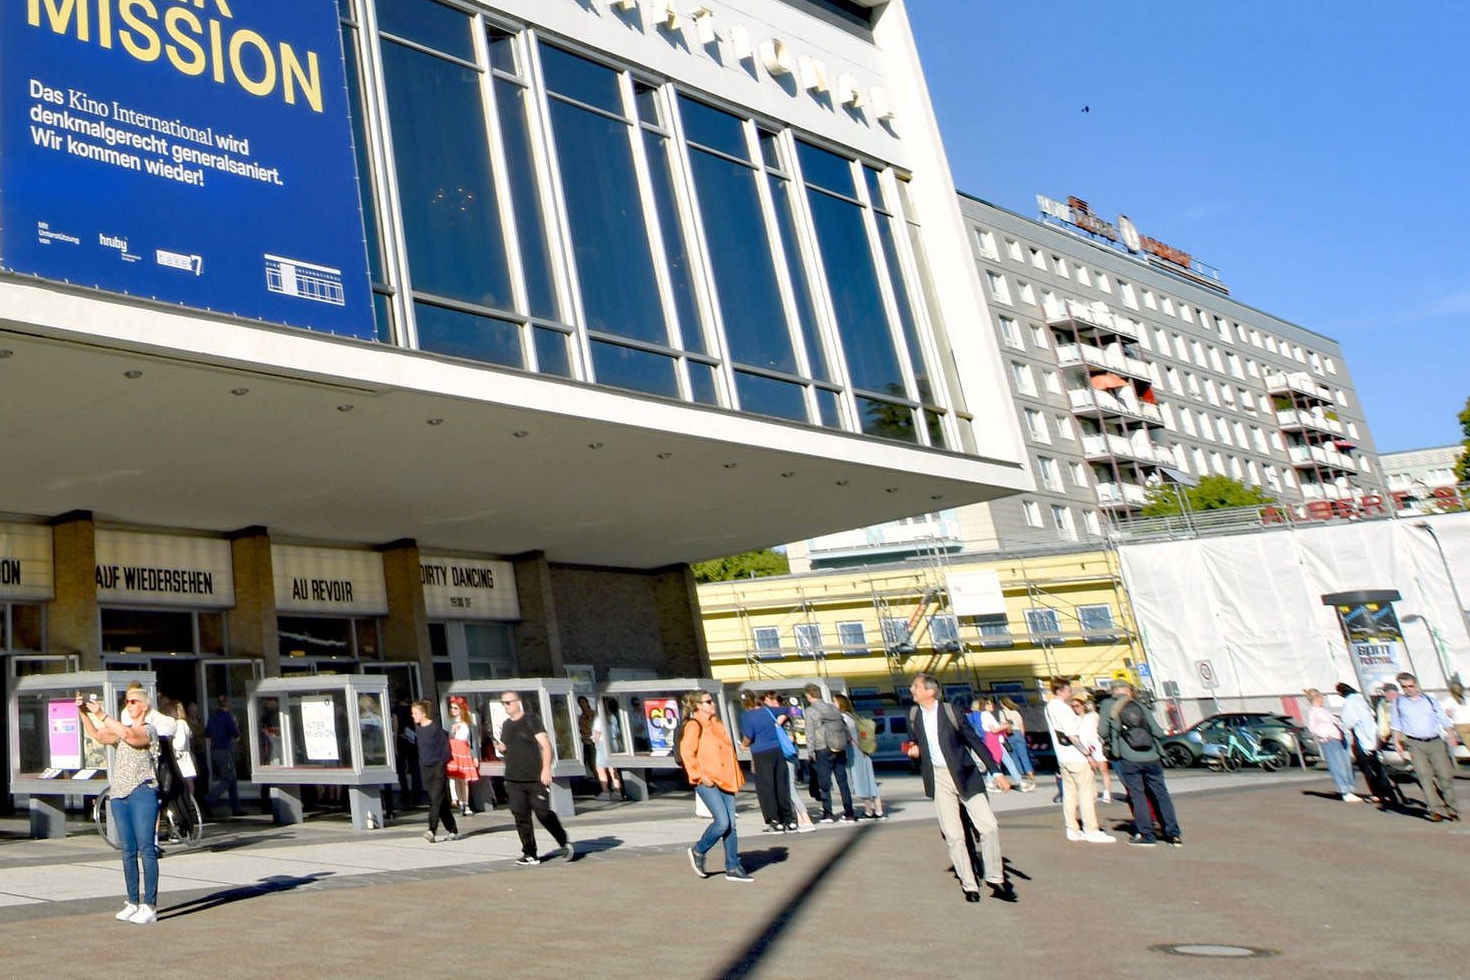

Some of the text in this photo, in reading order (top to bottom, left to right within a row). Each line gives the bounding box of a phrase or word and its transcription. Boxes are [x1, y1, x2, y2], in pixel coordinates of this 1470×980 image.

[30, 79, 250, 156] Das Kino International wird
[30, 104, 284, 186] denkmalgerecht generalsaniert.
[30, 124, 205, 187] Wir kommen wieder!
[95, 565, 213, 595] AUF WIEDERSEHEN
[293, 578, 354, 603] AU REVOIR
[451, 566, 494, 589] DANCING
